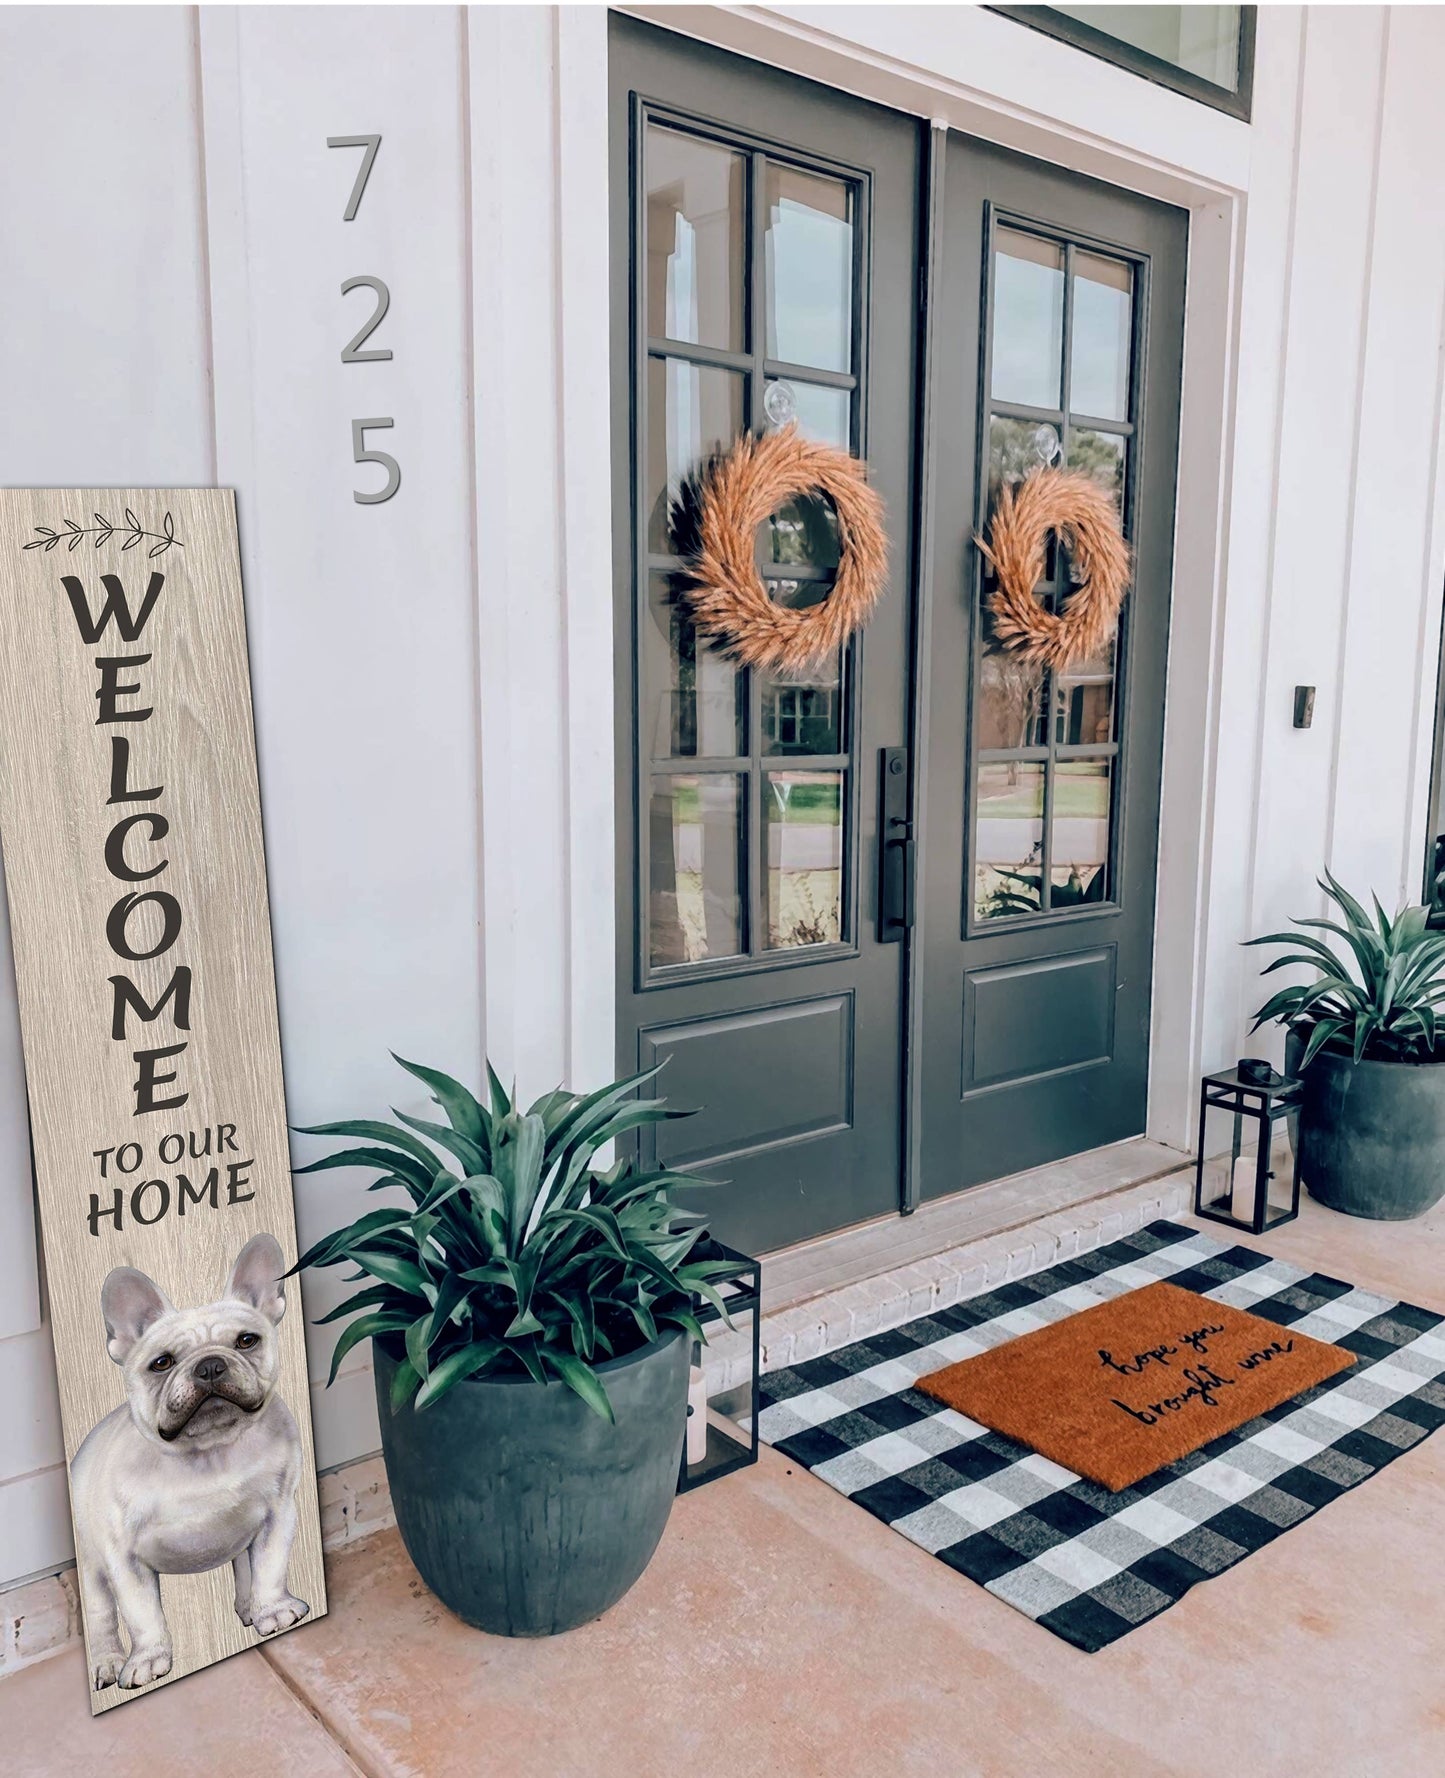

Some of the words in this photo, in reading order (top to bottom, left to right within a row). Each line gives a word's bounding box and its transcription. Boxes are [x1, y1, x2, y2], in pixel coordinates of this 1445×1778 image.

[326, 133, 401, 504] 725
[60, 571, 192, 1116] WELCOME
[92, 1142, 144, 1178] TO
[158, 1123, 239, 1165] OUR
[86, 1159, 256, 1237] HOME
[1098, 1344, 1178, 1375] hope
[1178, 1323, 1225, 1353] you
[1109, 1364, 1236, 1425] brought
